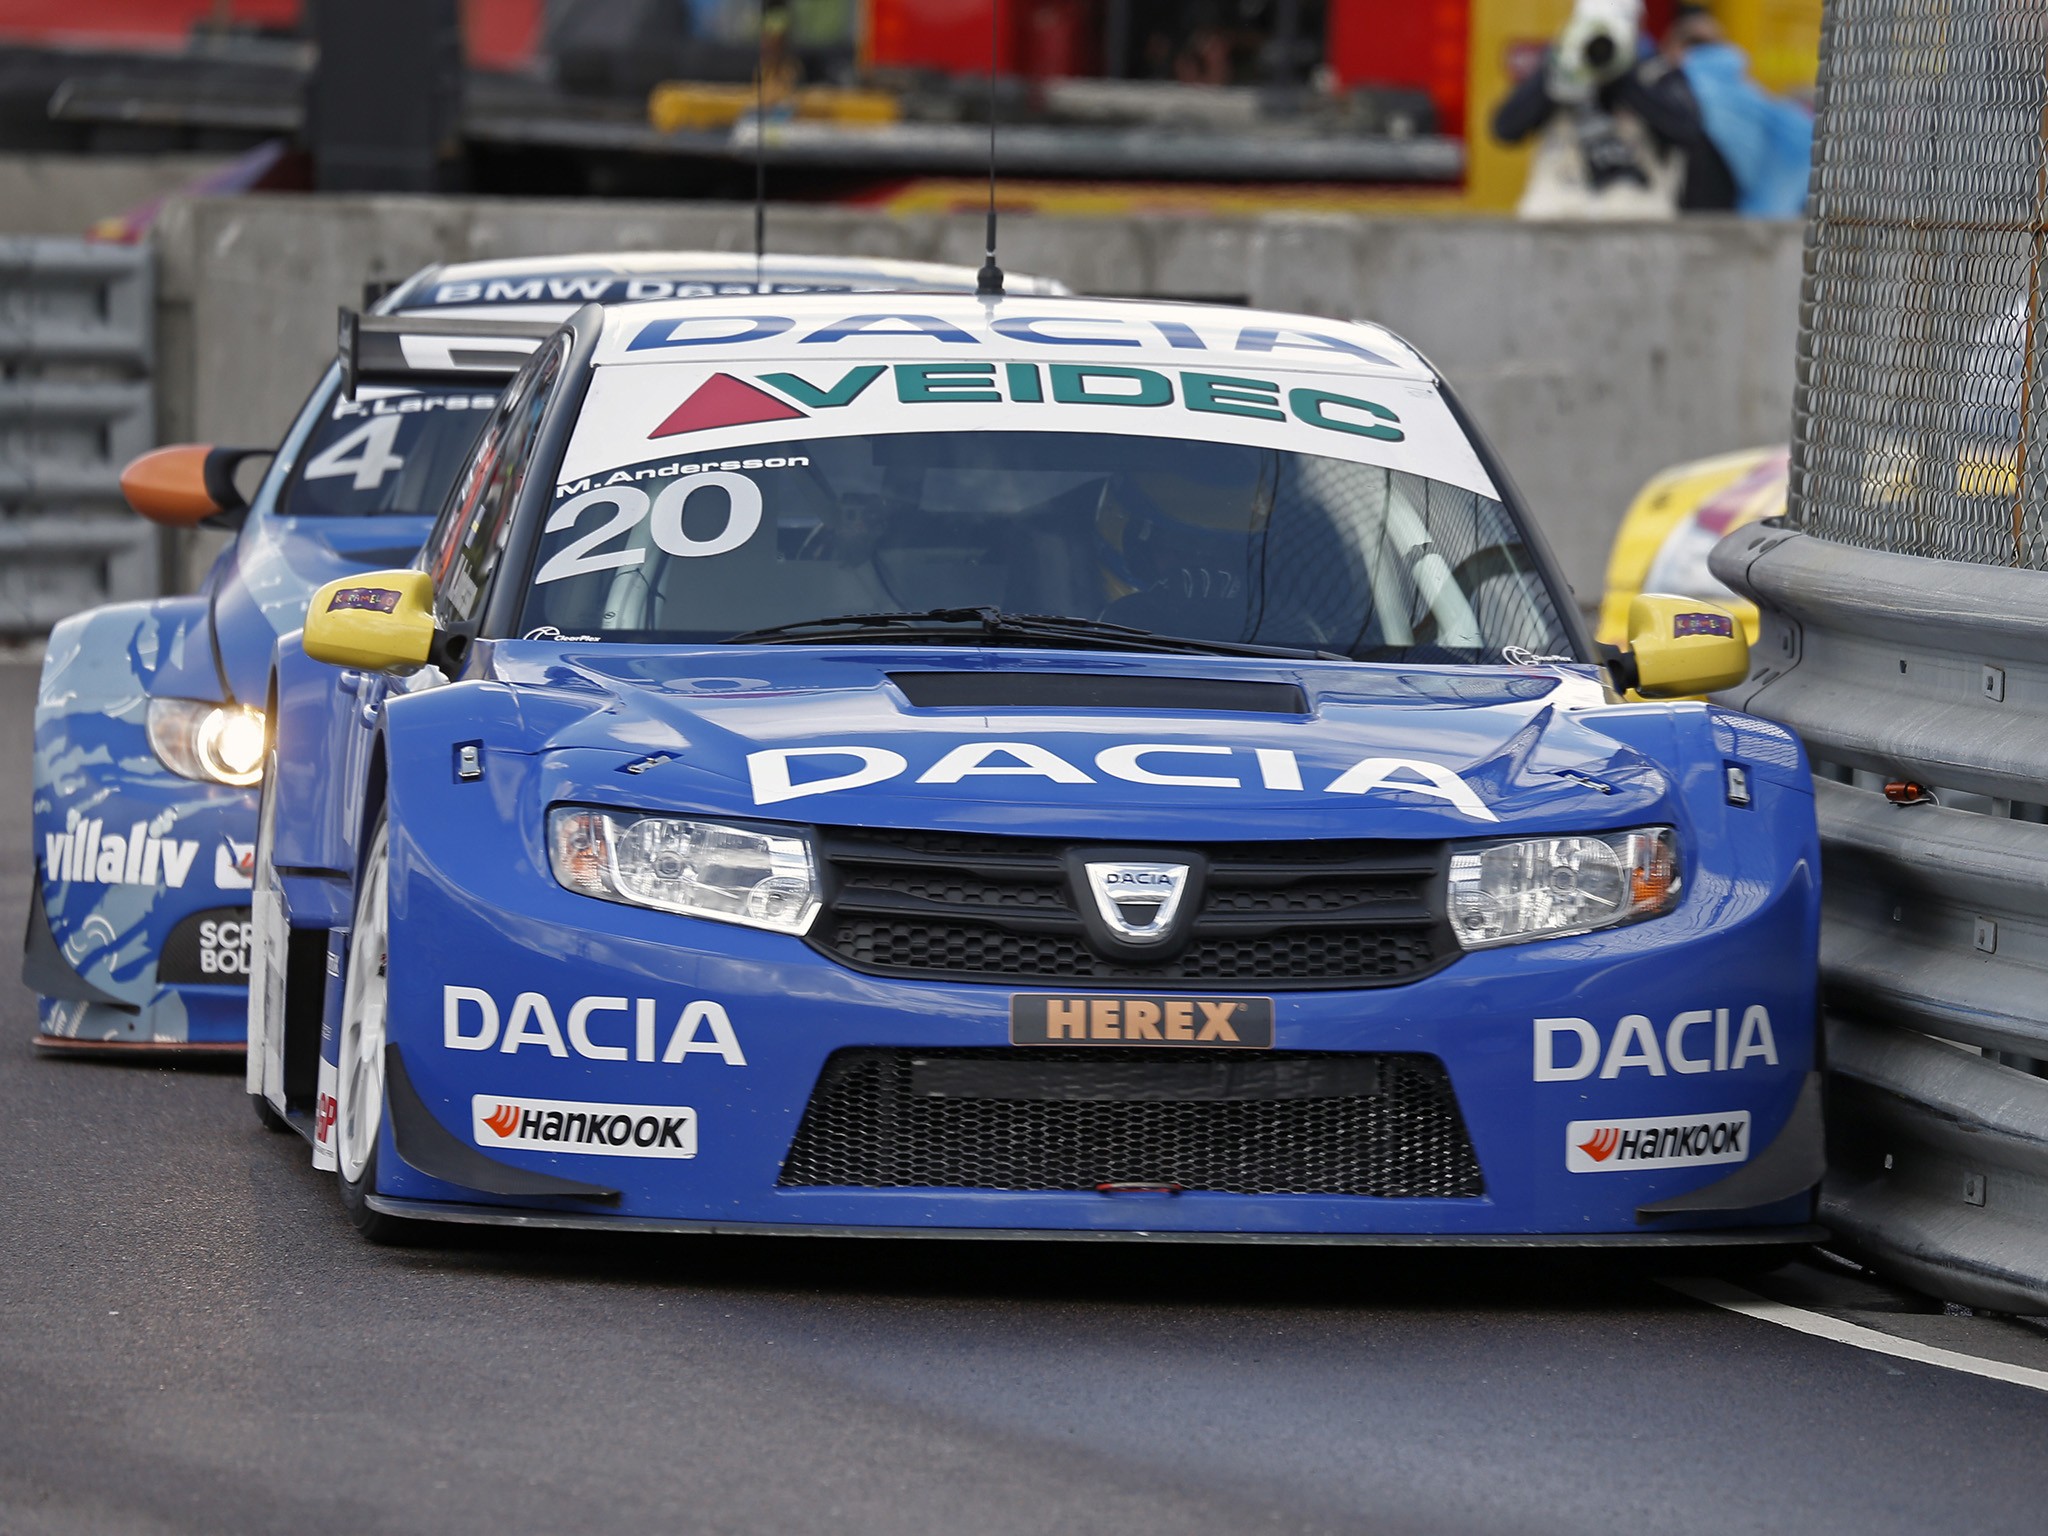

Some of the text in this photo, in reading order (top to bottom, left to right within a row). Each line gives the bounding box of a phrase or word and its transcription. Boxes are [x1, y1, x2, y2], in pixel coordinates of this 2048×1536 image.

[436, 277, 611, 303] BMW
[625, 314, 1403, 368] DACIA
[753, 362, 1405, 443] VEIDEC
[304, 414, 404, 490] 4
[534, 471, 763, 585] 20
[745, 742, 1501, 823] DACIA
[46, 818, 199, 888] villaliv
[1106, 872, 1173, 886] DACIA
[443, 984, 748, 1066] DACIA
[1533, 1004, 1779, 1083] DACIA
